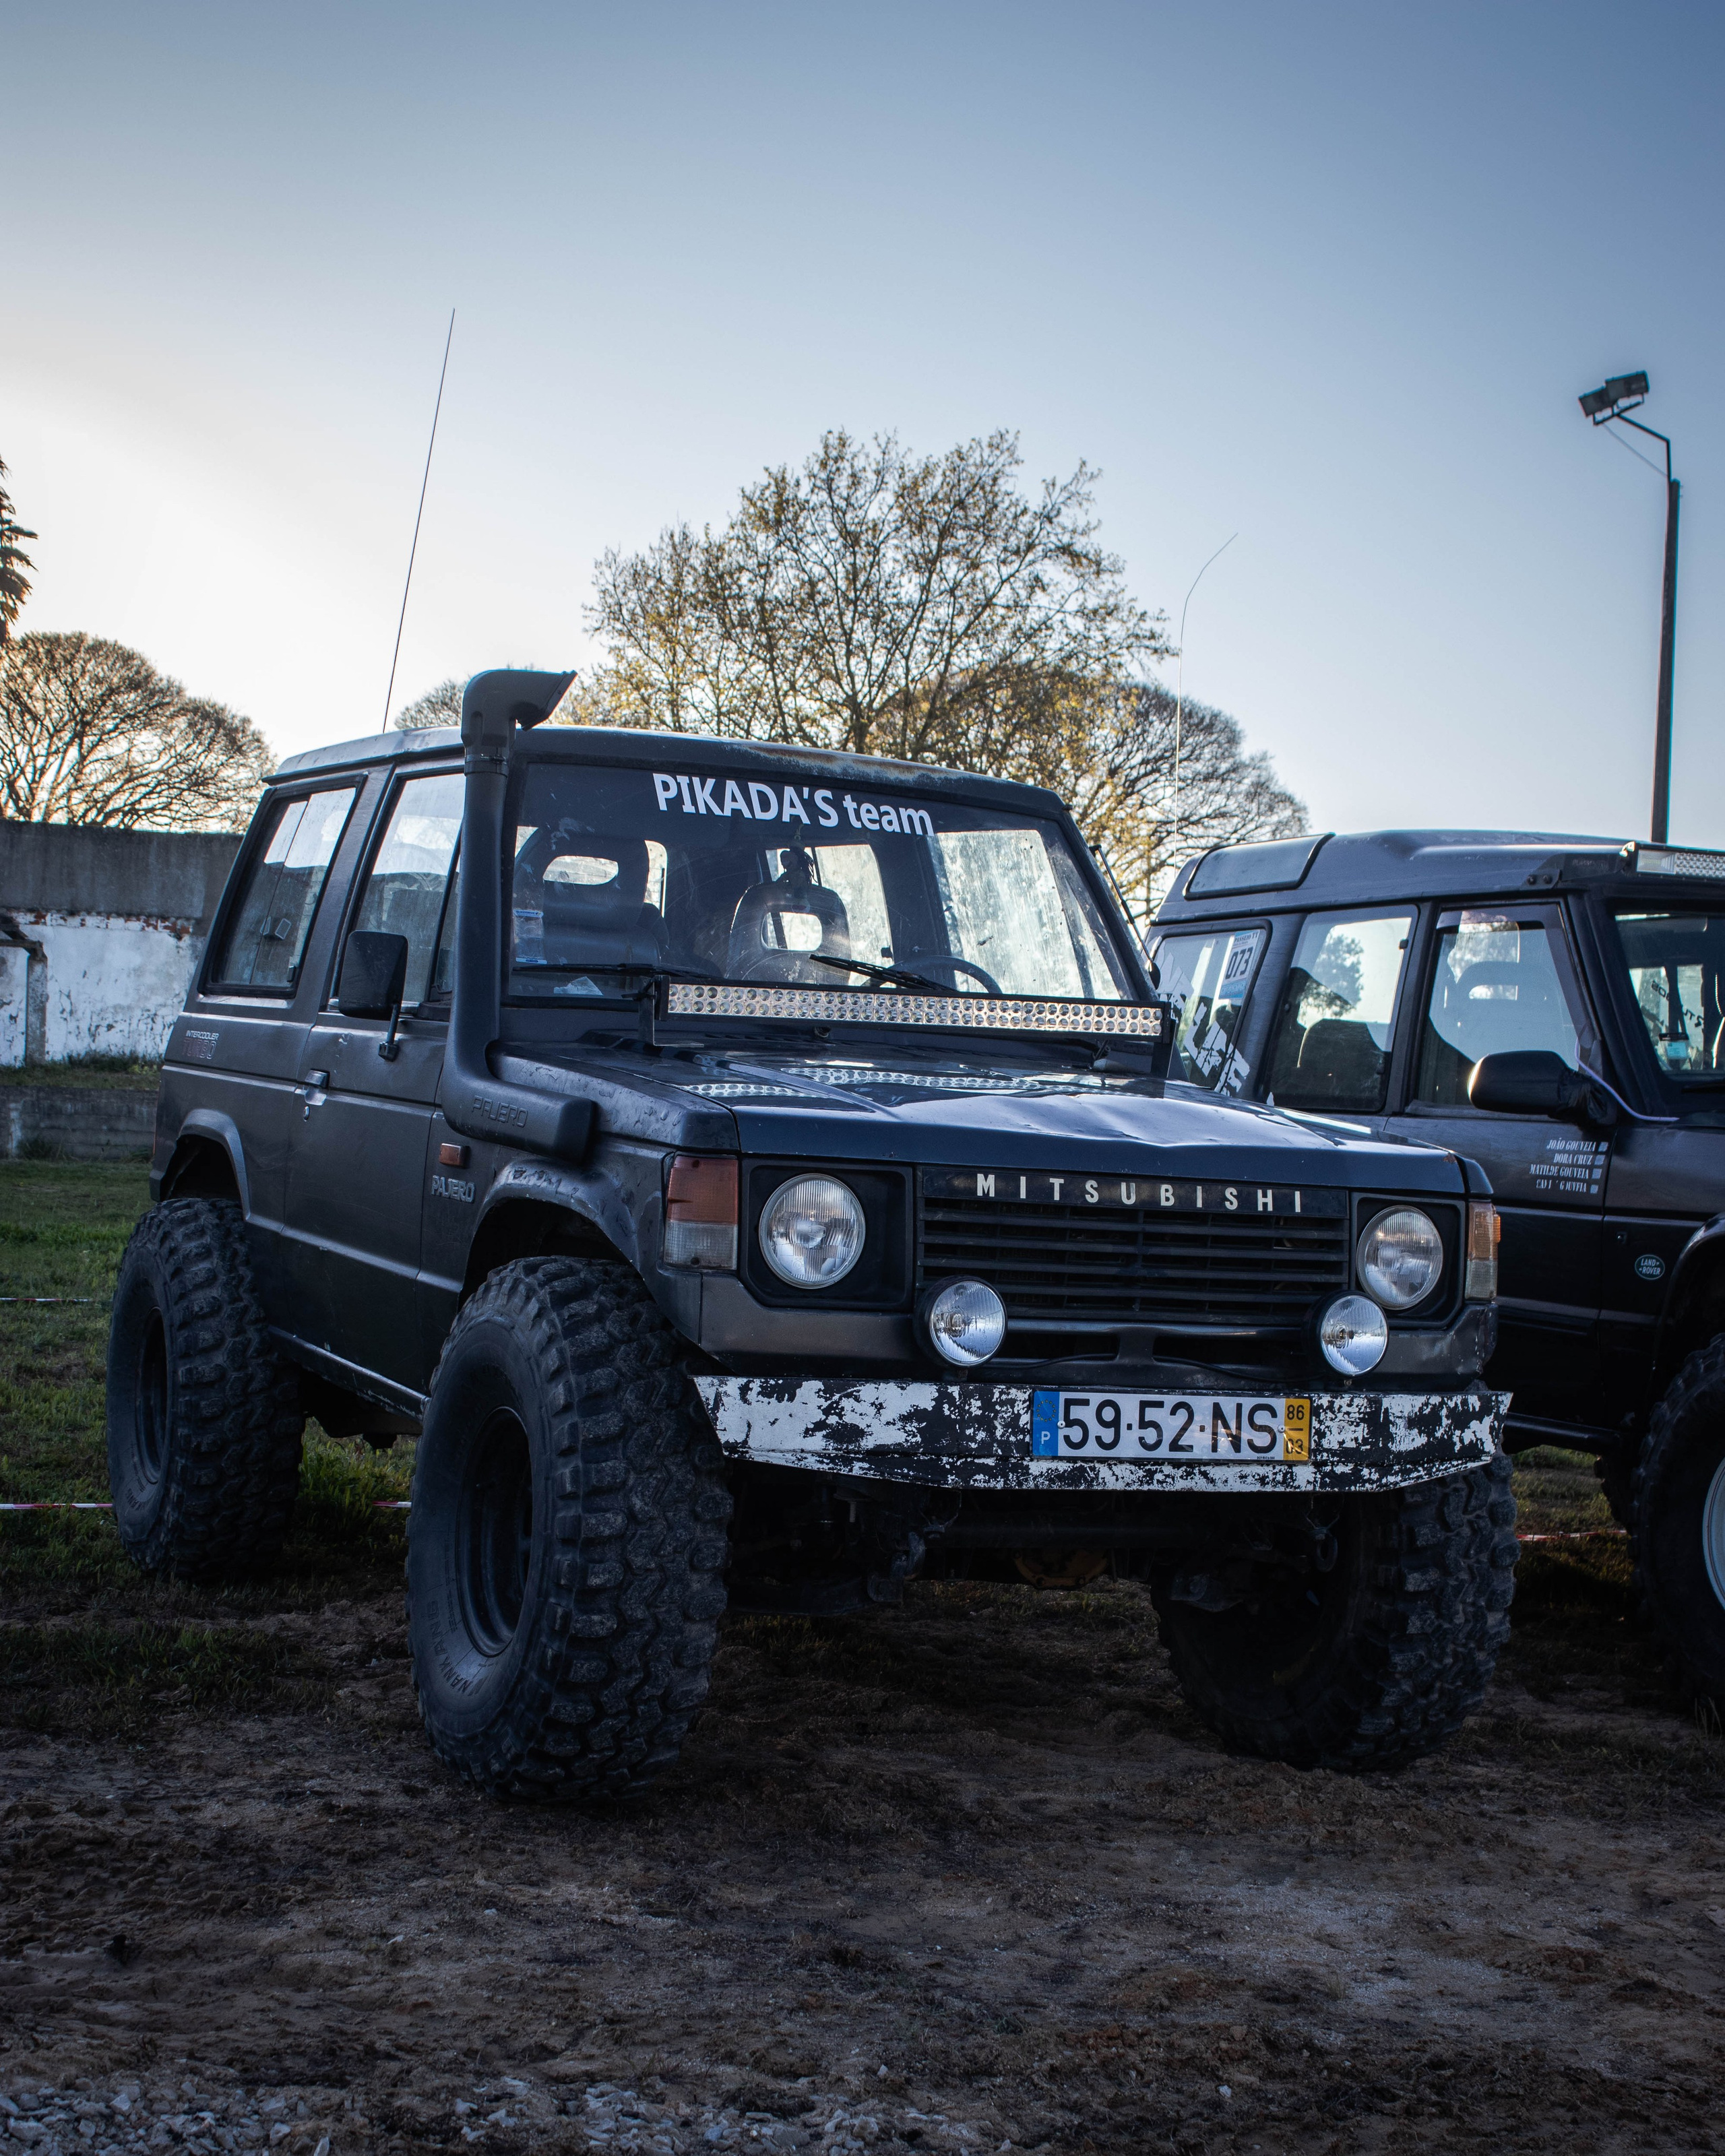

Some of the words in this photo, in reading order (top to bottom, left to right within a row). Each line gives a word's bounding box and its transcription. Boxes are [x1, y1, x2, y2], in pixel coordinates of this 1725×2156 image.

[652, 773, 839, 828] PIKADA'S
[843, 794, 935, 837] team
[1225, 946, 1253, 980] 073
[186, 1029, 220, 1040] INTERCOOLER
[183, 1037, 216, 1059] TURBO
[472, 1095, 528, 1128] PAJERO
[1565, 1141, 1596, 1151] GOUVEIA
[1553, 1153, 1573, 1164] DORA
[1573, 1154, 1594, 1165] CRUZ
[1530, 1164, 1559, 1176] MATILDE
[1559, 1167, 1589, 1179] GOUVEIA
[431, 1174, 475, 1203] PAJERO
[976, 1173, 1301, 1213] MITSUBISHI
[1640, 1258, 1656, 1267] LAND
[1641, 1266, 1661, 1275] ROVER
[1287, 1404, 1305, 1420] 86
[1041, 1431, 1050, 1445] P
[427, 1600, 472, 1694] NANKANG
